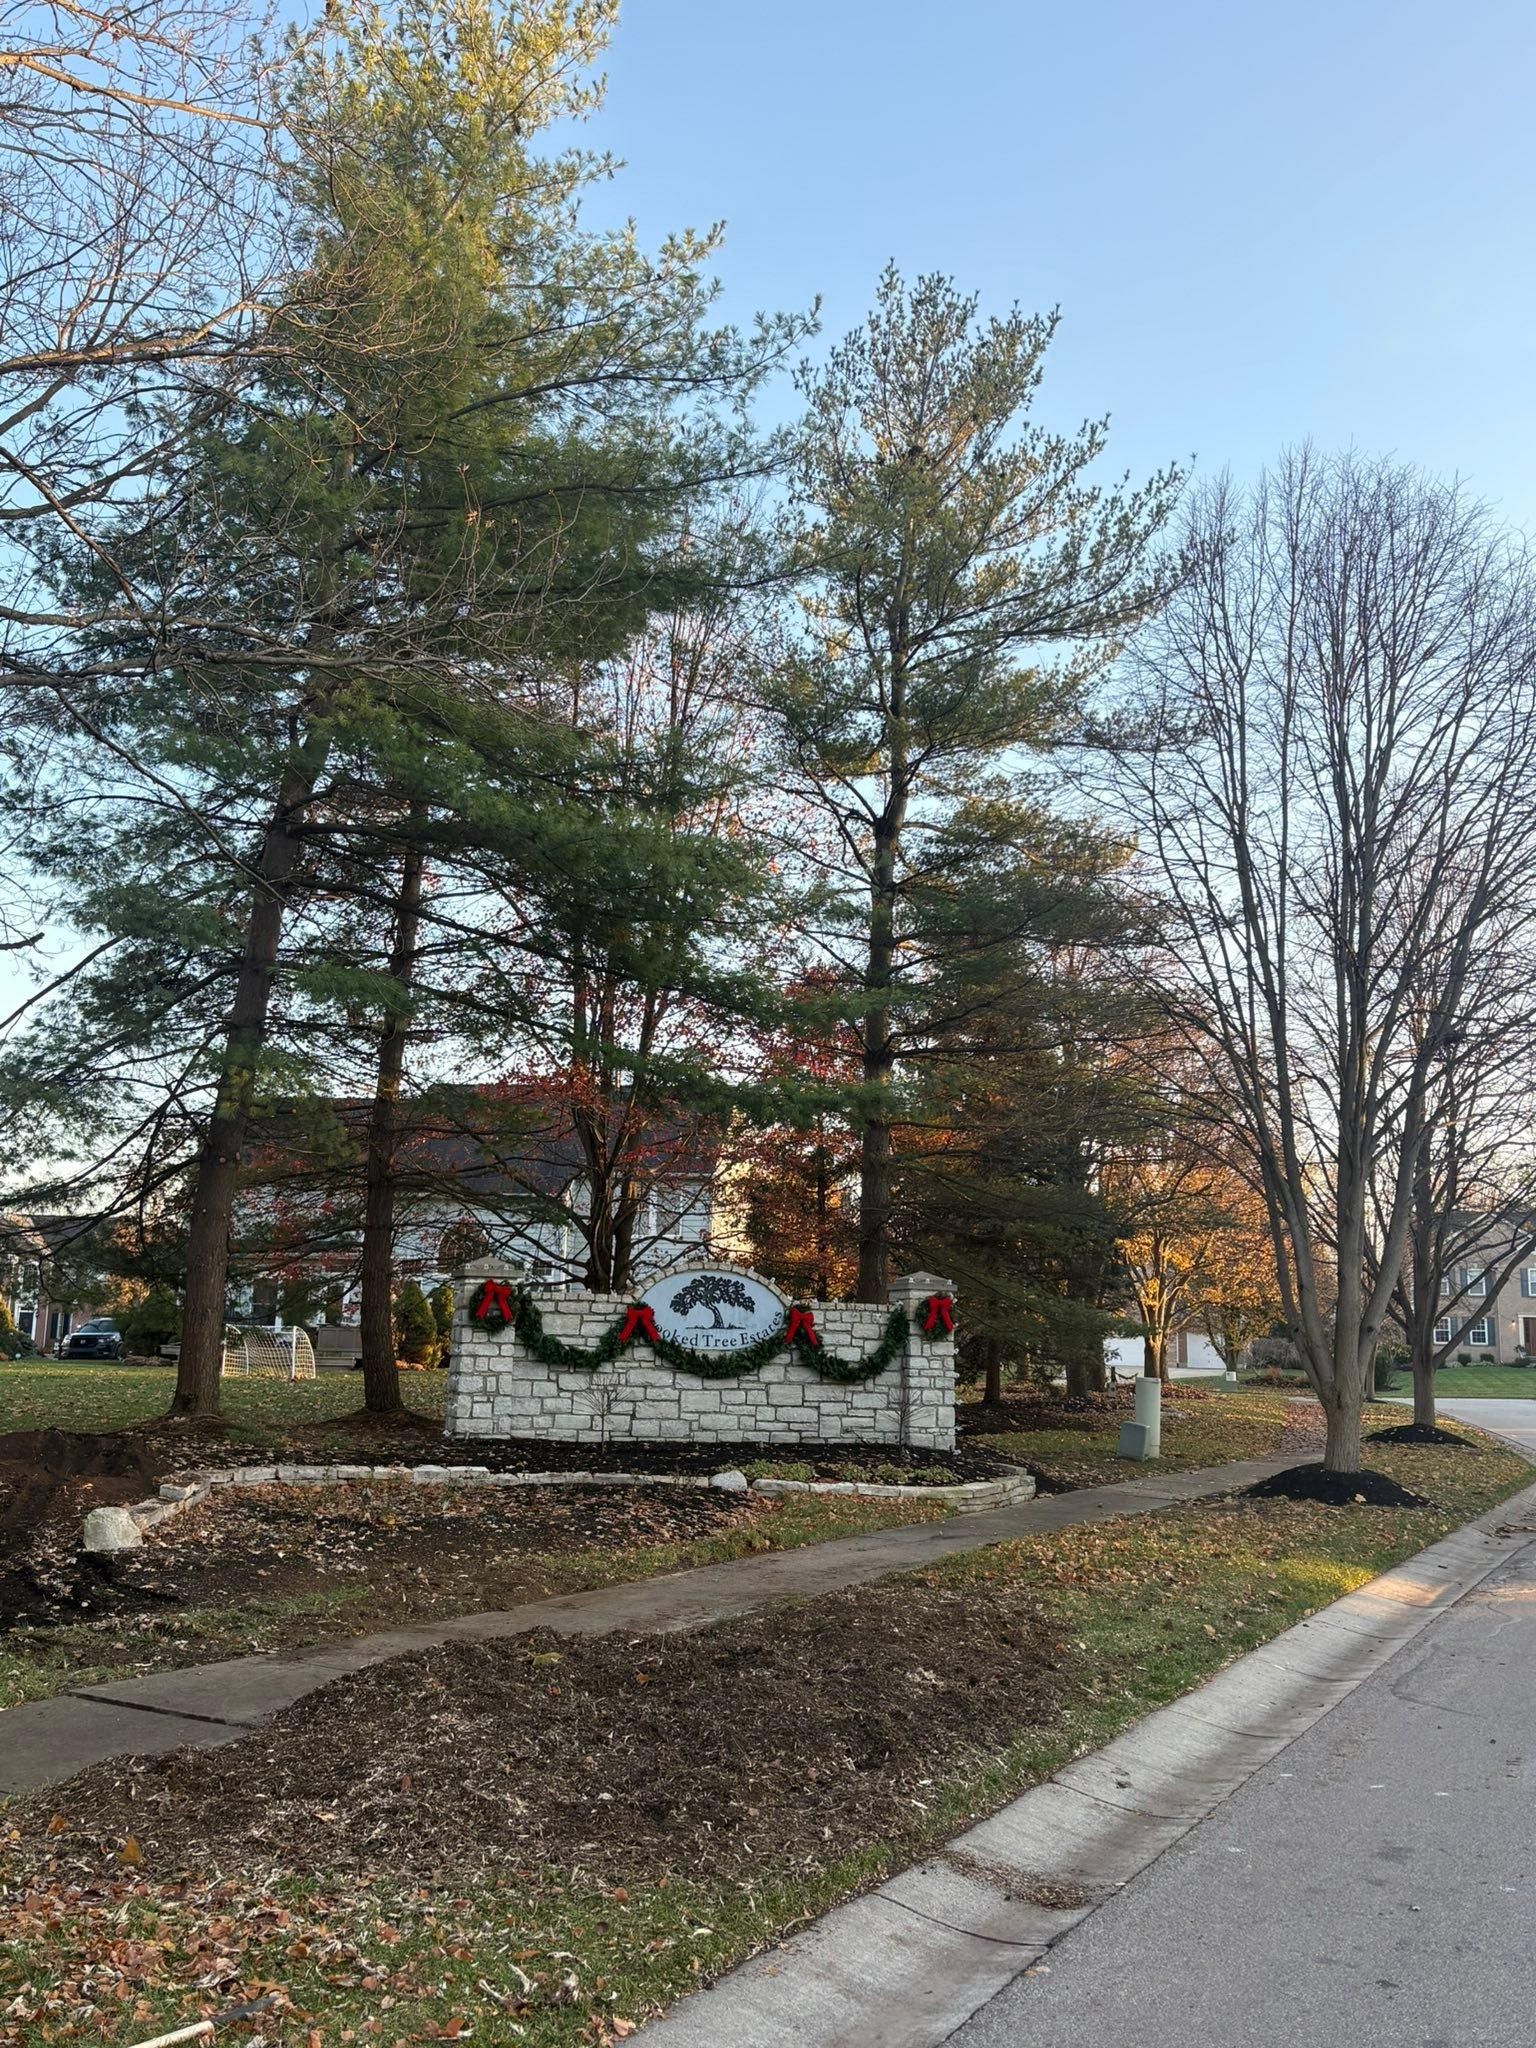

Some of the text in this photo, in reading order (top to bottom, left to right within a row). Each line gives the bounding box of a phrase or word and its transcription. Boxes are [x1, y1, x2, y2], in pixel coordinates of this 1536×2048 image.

[650, 1311, 783, 1348] ooked Tree Estates
